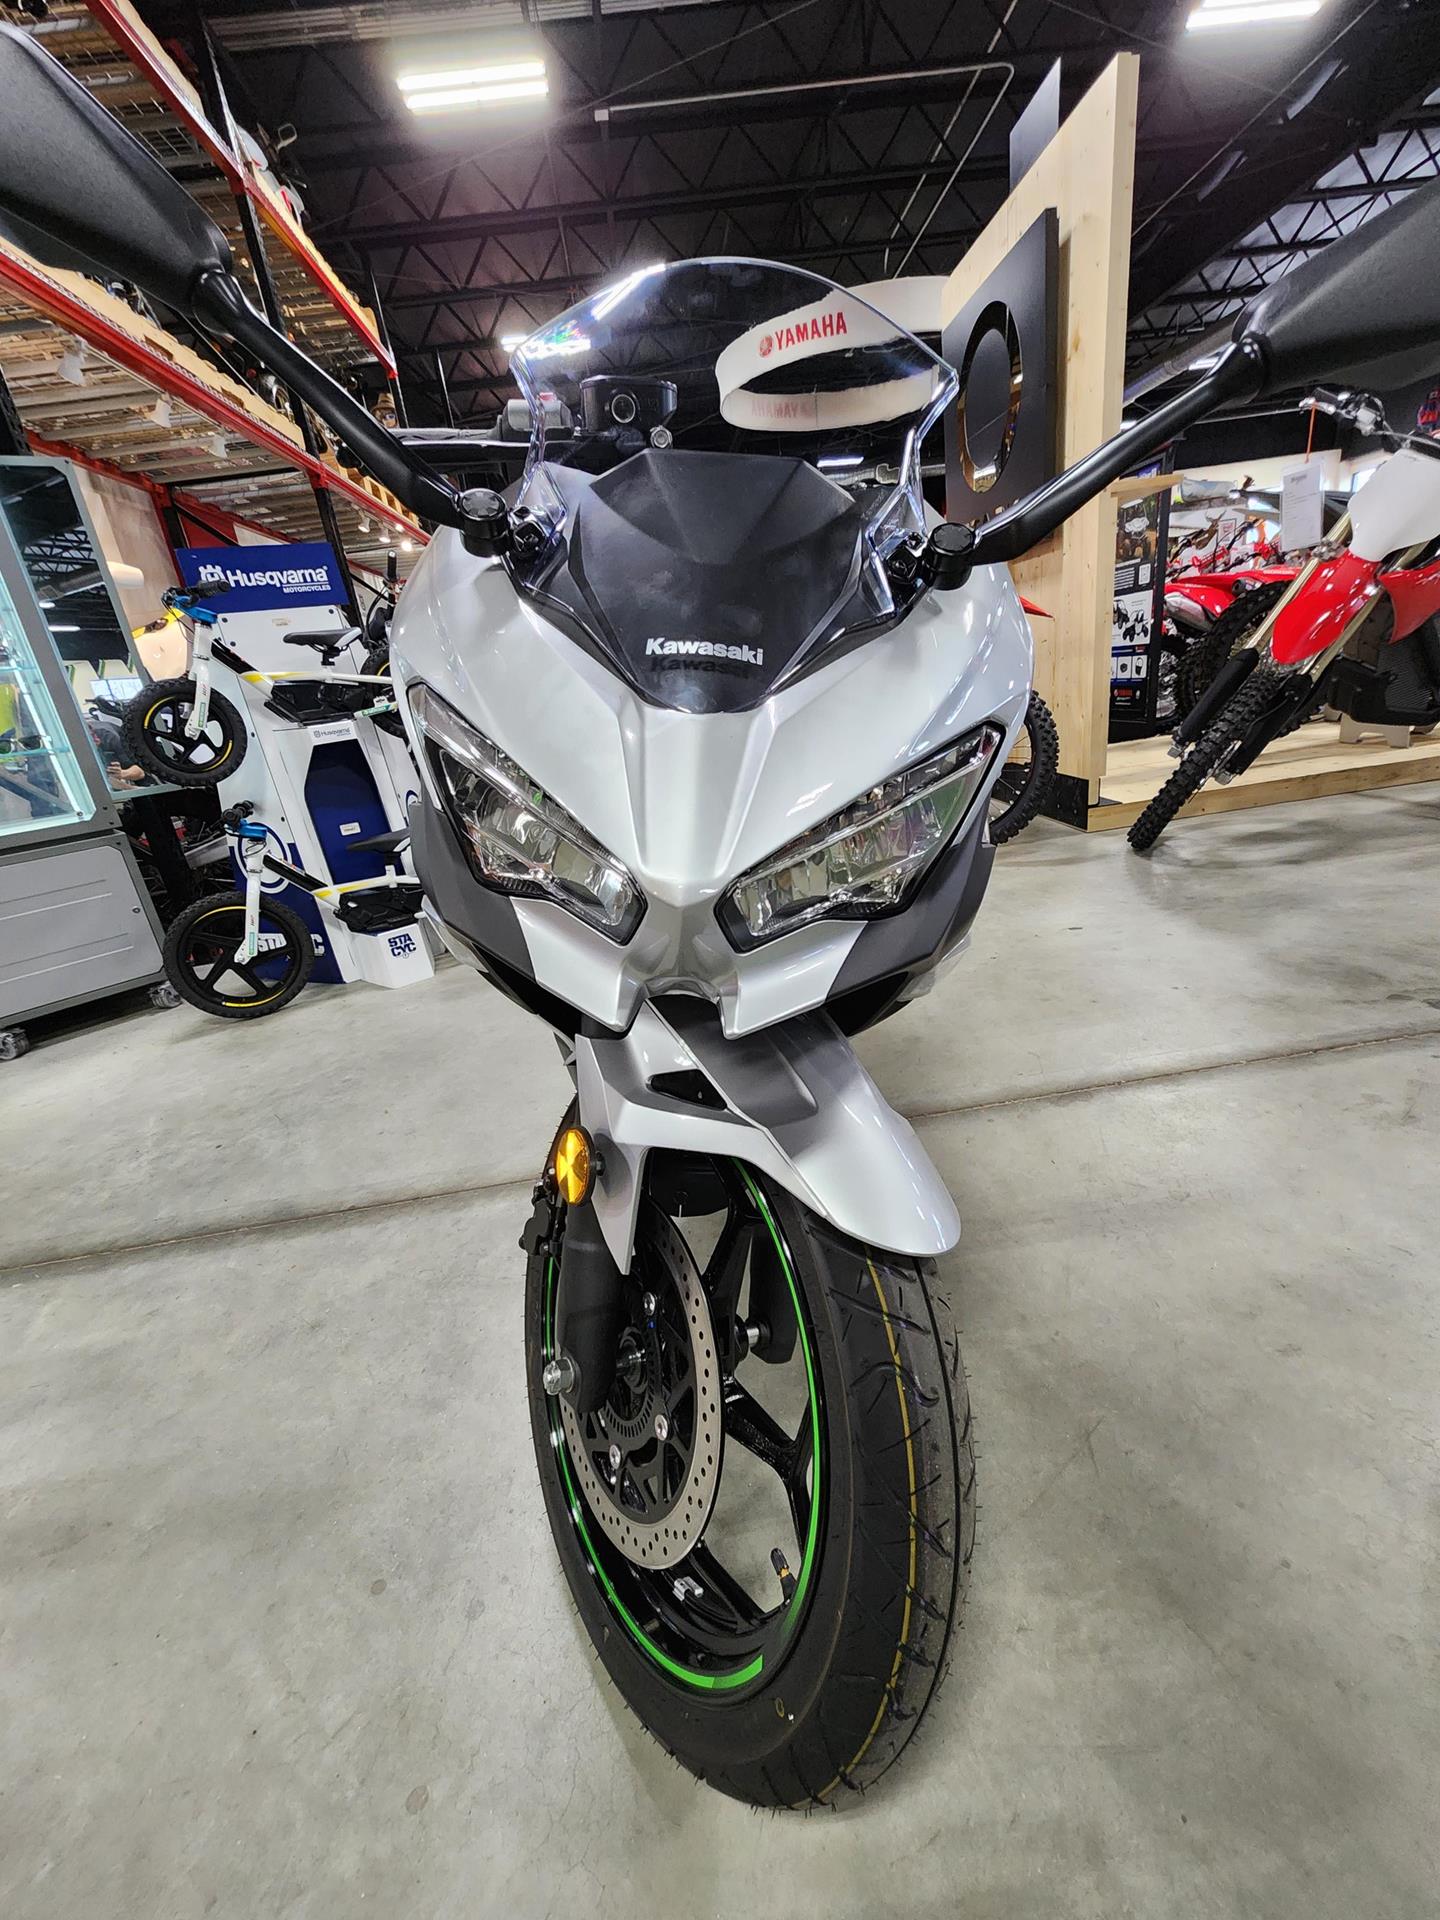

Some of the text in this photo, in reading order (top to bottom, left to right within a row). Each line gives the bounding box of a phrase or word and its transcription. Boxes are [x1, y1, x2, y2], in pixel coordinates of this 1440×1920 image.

[775, 311, 848, 350] YAMAHA
[226, 566, 328, 588] Husqvarna
[283, 584, 331, 594] MOTORCYCLES
[645, 637, 764, 666] Kawasaki
[388, 933, 413, 947] STA
[391, 942, 416, 956] CYC
